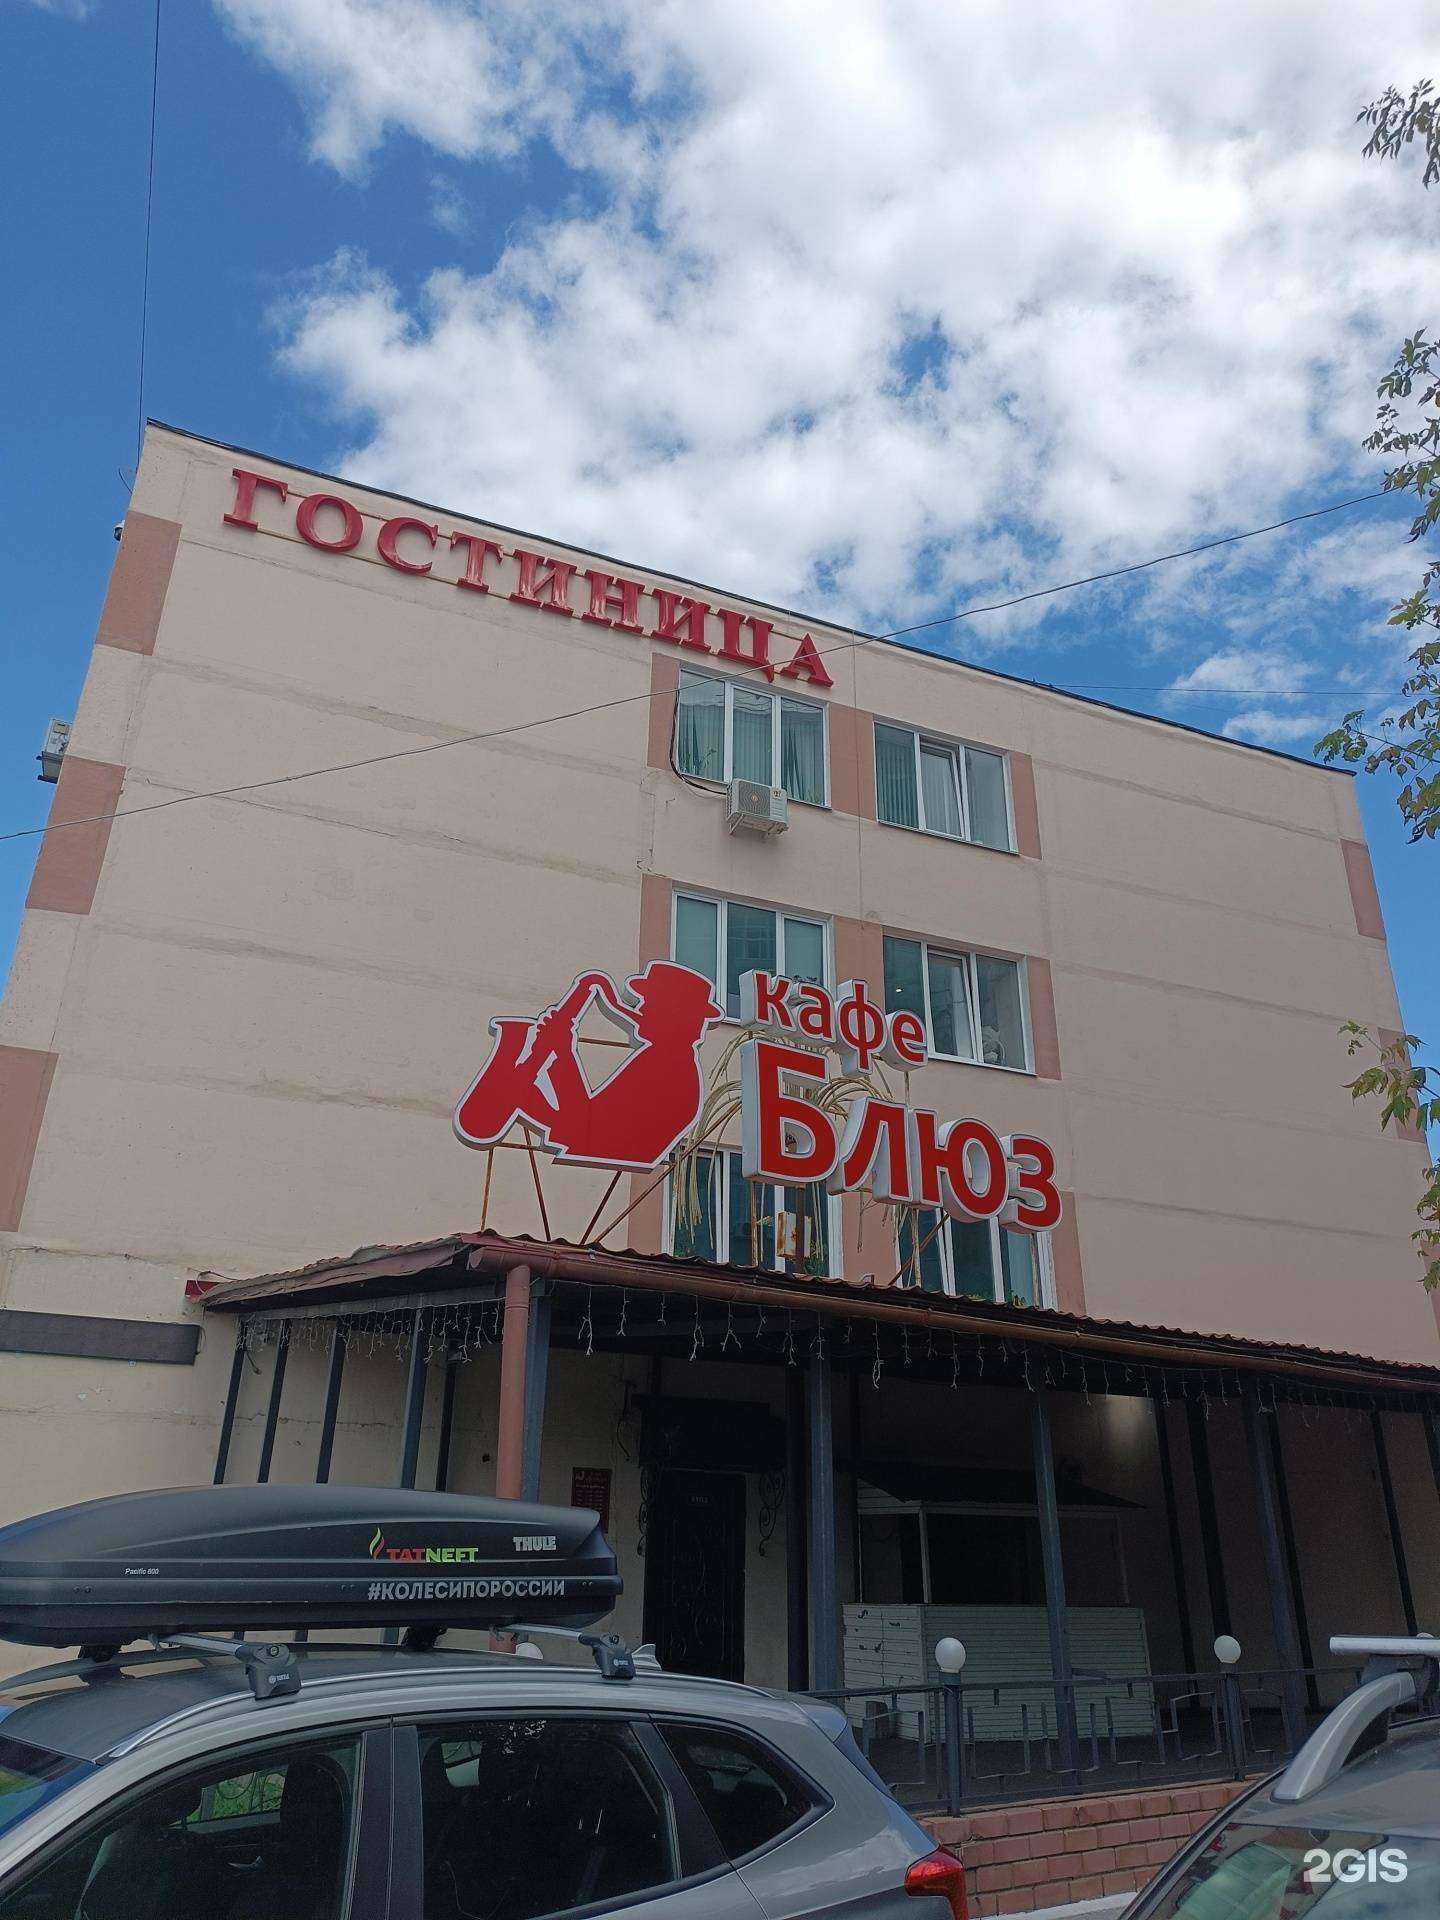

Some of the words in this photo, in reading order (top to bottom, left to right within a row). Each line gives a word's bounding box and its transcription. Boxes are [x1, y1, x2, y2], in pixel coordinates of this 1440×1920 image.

[223, 467, 834, 687] ГОСТИНИЦА
[753, 968, 928, 1076] кафе
[512, 1535, 557, 1552] THULE
[386, 1547, 479, 1563] TATNEFT
[124, 1567, 147, 1575] Pacific
[367, 1579, 566, 1600] #КОЛЕСИПОРОССИИ
